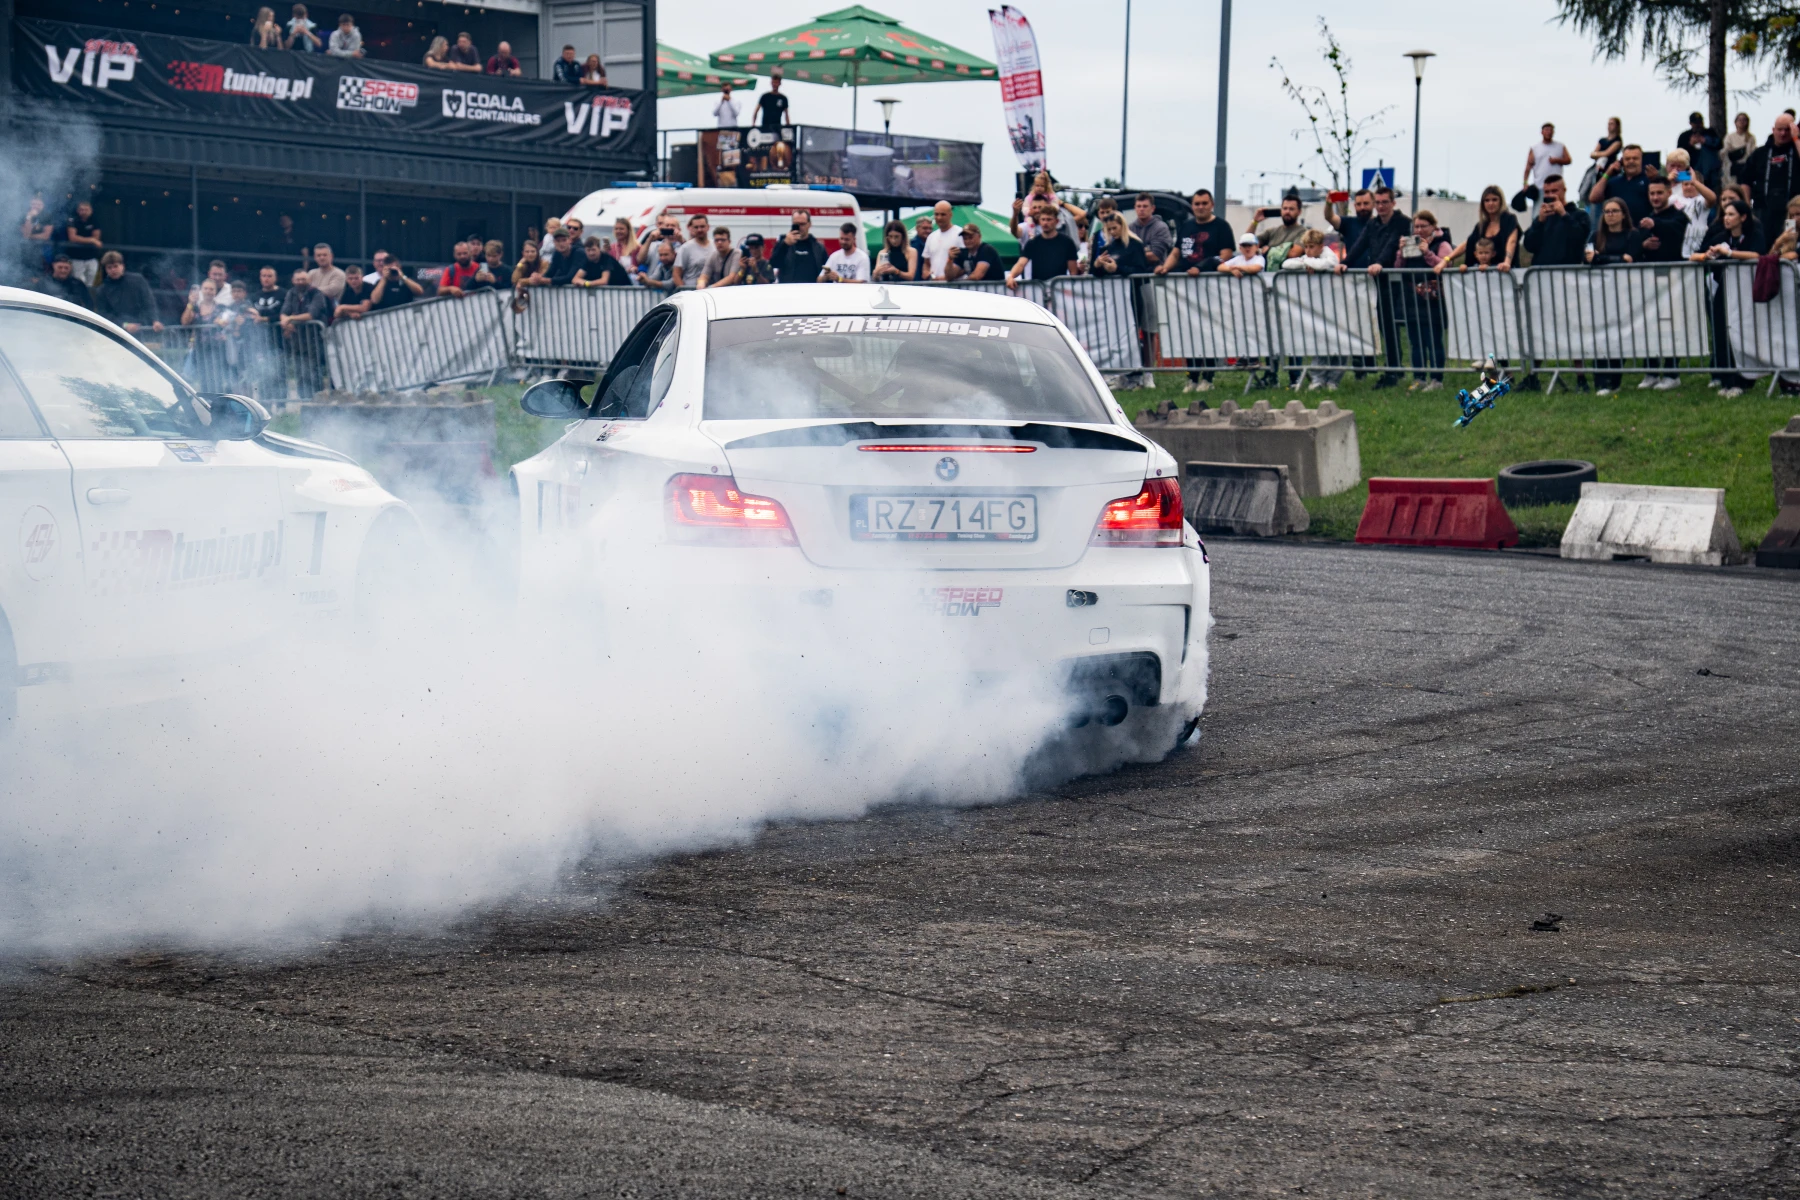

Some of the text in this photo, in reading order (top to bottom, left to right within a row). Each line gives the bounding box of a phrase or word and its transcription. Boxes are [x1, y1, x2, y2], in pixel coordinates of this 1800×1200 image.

[44, 44, 136, 88] VIP
[361, 80, 418, 100] SPEED
[348, 94, 400, 111] SHOW
[466, 92, 525, 112] COALA
[466, 108, 541, 125] CONTAINERS
[564, 101, 631, 137] VIP
[823, 316, 1010, 338] Mtuning.pl
[856, 520, 867, 528] PL
[875, 500, 1026, 531] RZ 714FG
[937, 587, 1004, 602] SPEED
[918, 602, 980, 616] HOW
